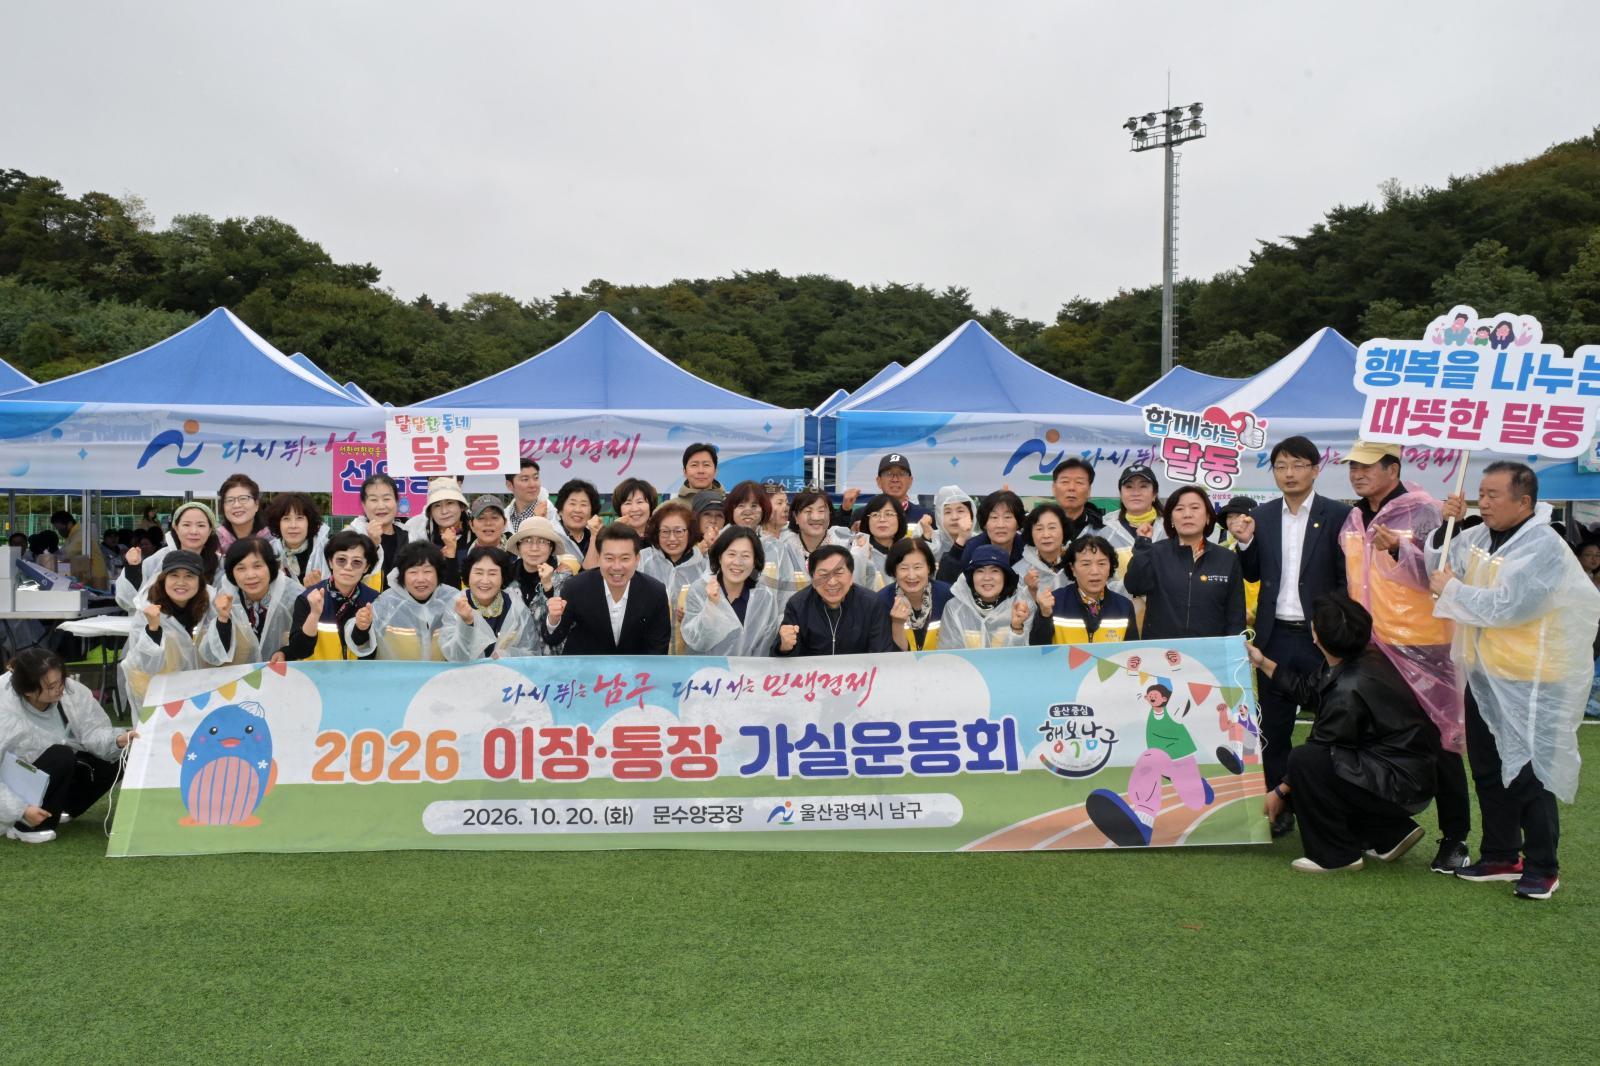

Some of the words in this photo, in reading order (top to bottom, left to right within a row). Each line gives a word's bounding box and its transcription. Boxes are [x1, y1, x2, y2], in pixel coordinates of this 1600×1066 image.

[1363, 347, 1480, 390] 행복을
[1145, 406, 1238, 447] 함께하는
[1369, 397, 1489, 441] 따뜻한
[1500, 402, 1585, 448] 달동
[222, 438, 277, 463] 다시
[280, 435, 318, 467] 뛰는
[519, 433, 641, 476] 민생경제
[1080, 447, 1128, 469] 다시
[1136, 444, 1164, 468] 뛰
[1161, 437, 1240, 491] 달동
[502, 680, 549, 703] 다시
[553, 679, 586, 709] 뛰는
[593, 672, 657, 710] 남구
[672, 678, 722, 703] 다시
[726, 675, 755, 700] 서는
[763, 666, 879, 707] 민생경제
[311, 730, 460, 782] 2026
[483, 725, 723, 781] 이장·통장
[739, 717, 1020, 777] 가실운동회
[462, 808, 523, 826] 2026.
[531, 808, 560, 826] 10.
[566, 807, 598, 826] 20.
[604, 806, 634, 826] (화)
[652, 804, 744, 825] 문수양궁장
[799, 801, 884, 822] 울산광역시
[889, 801, 924, 821] 남구
